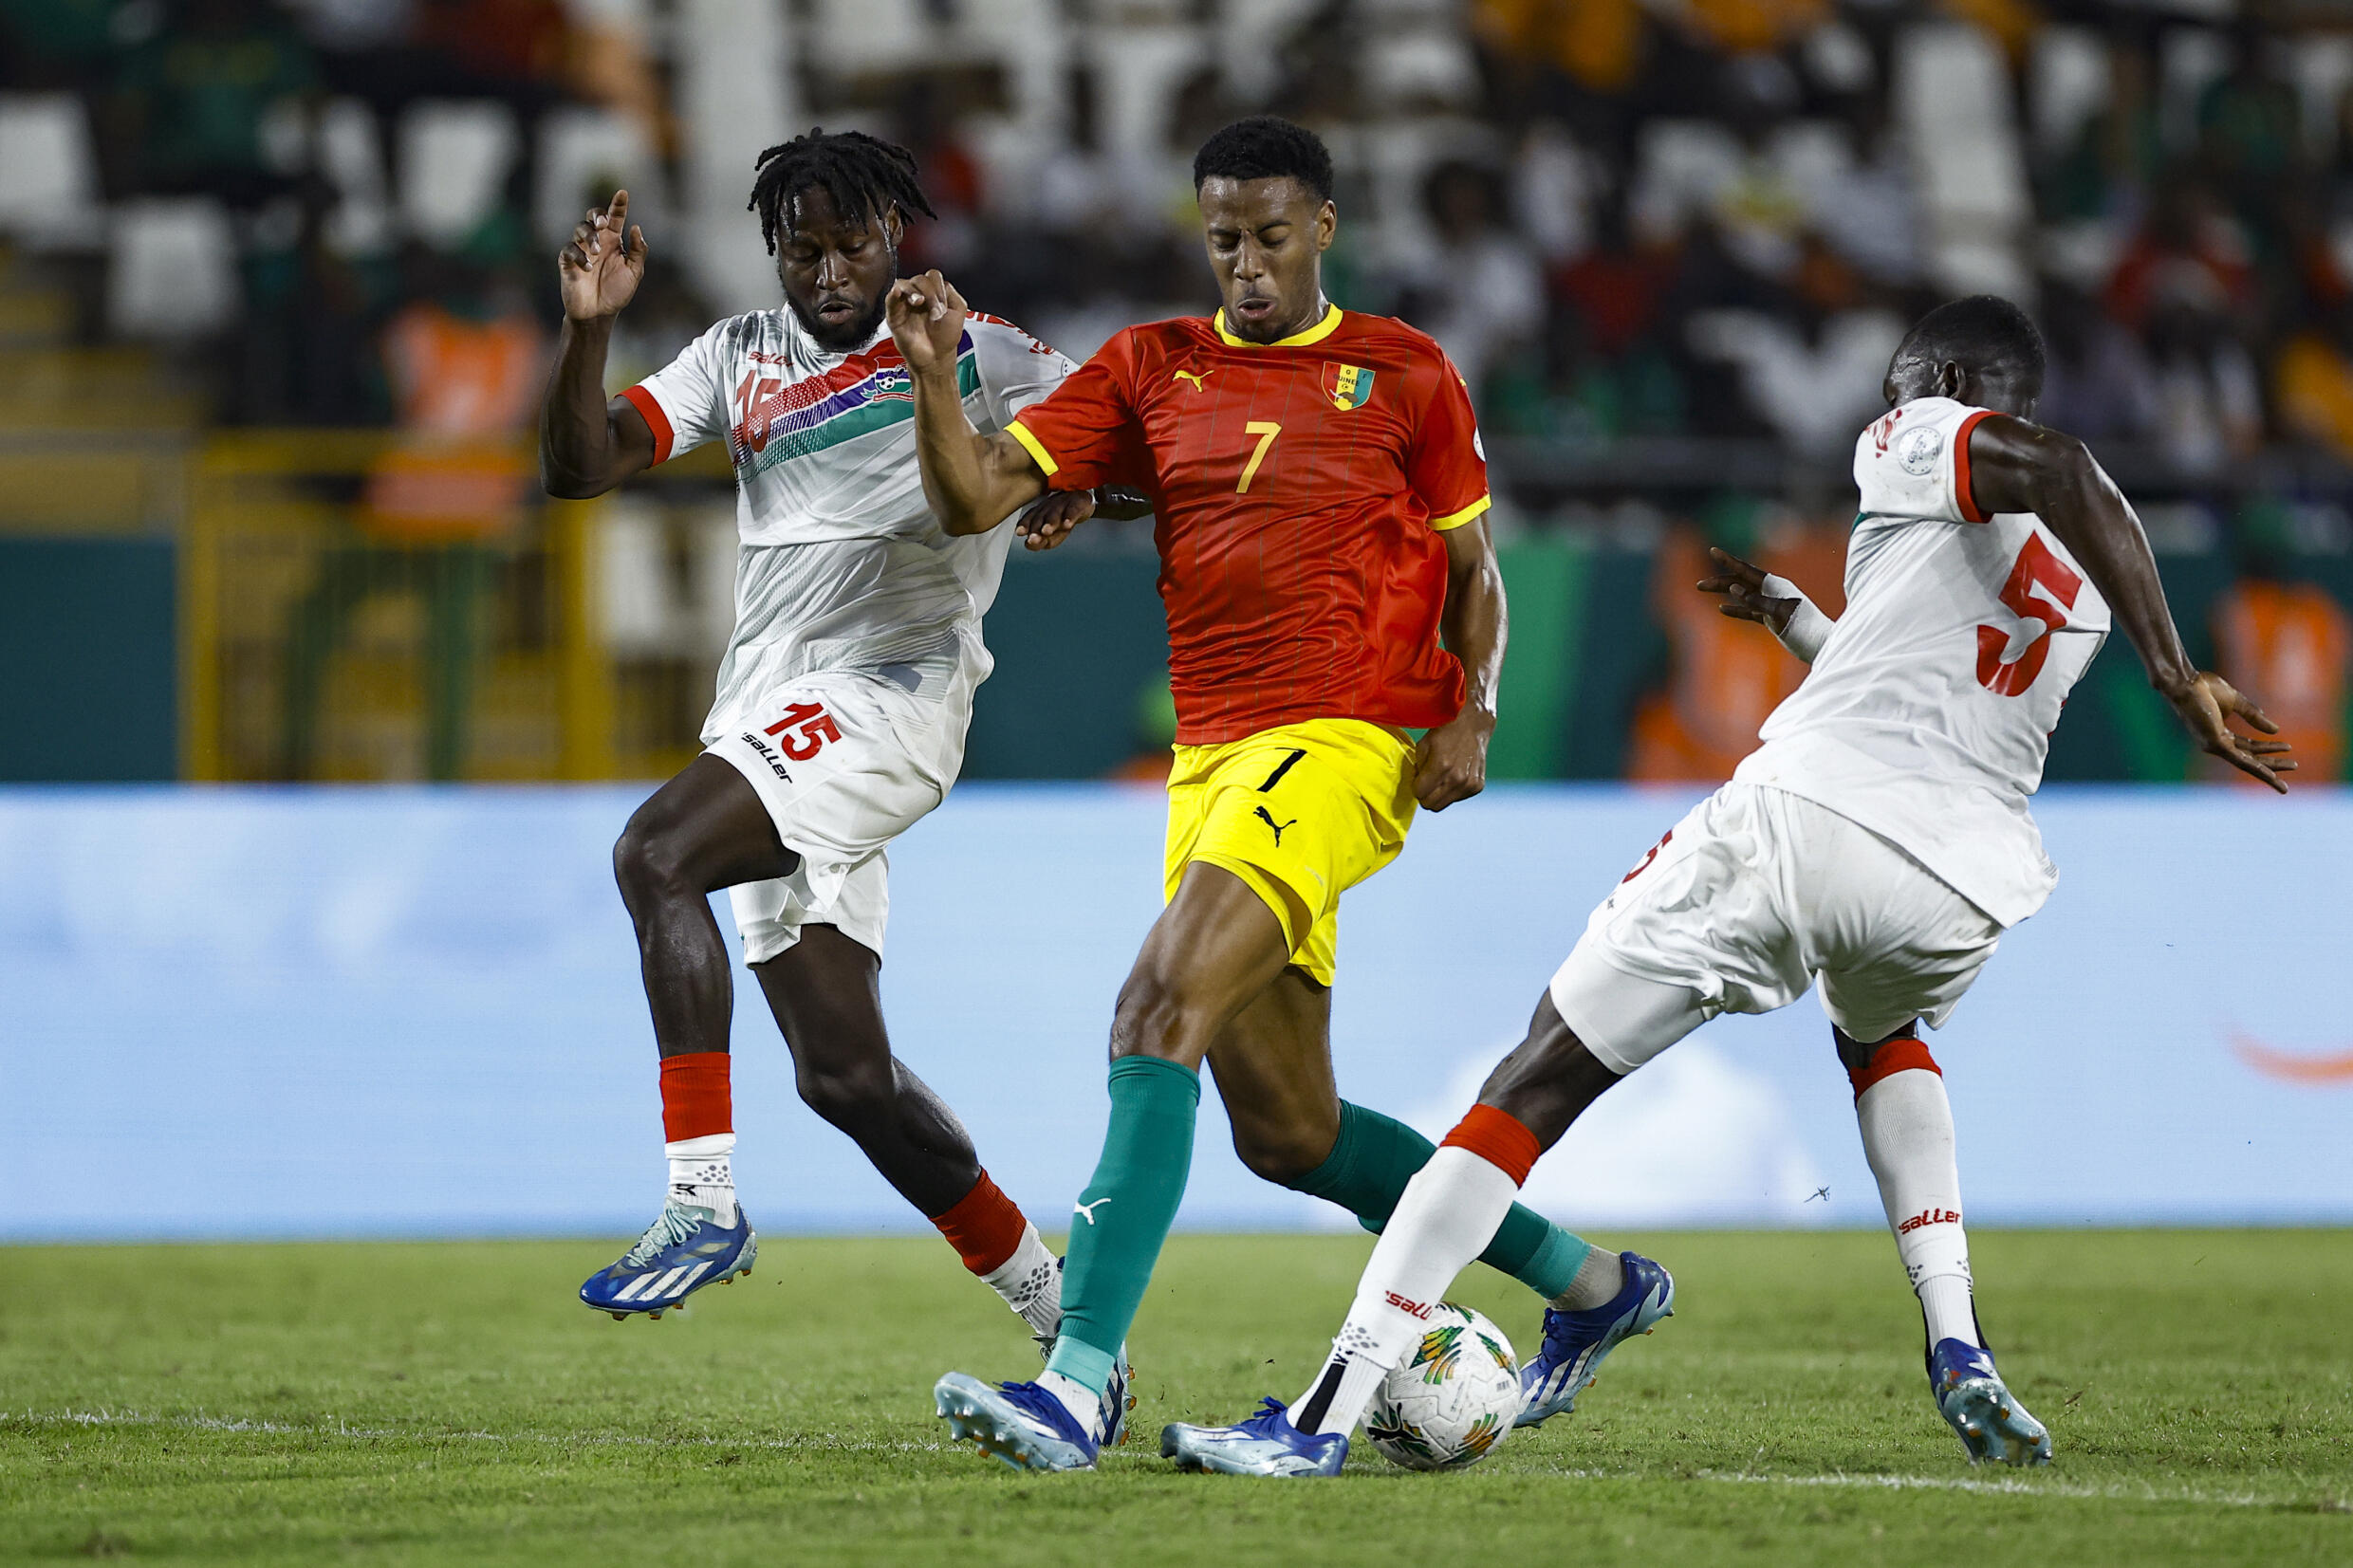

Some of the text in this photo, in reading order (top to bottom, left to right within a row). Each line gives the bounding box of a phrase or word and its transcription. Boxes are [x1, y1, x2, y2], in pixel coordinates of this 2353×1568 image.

[735, 369, 783, 453] 15
[1236, 421, 1283, 494] 7
[1976, 529, 2084, 698] 5
[740, 731, 793, 784] saller
[764, 702, 843, 762] 15
[1898, 1208, 1961, 1235] saller
[1385, 1290, 1433, 1320] sall
